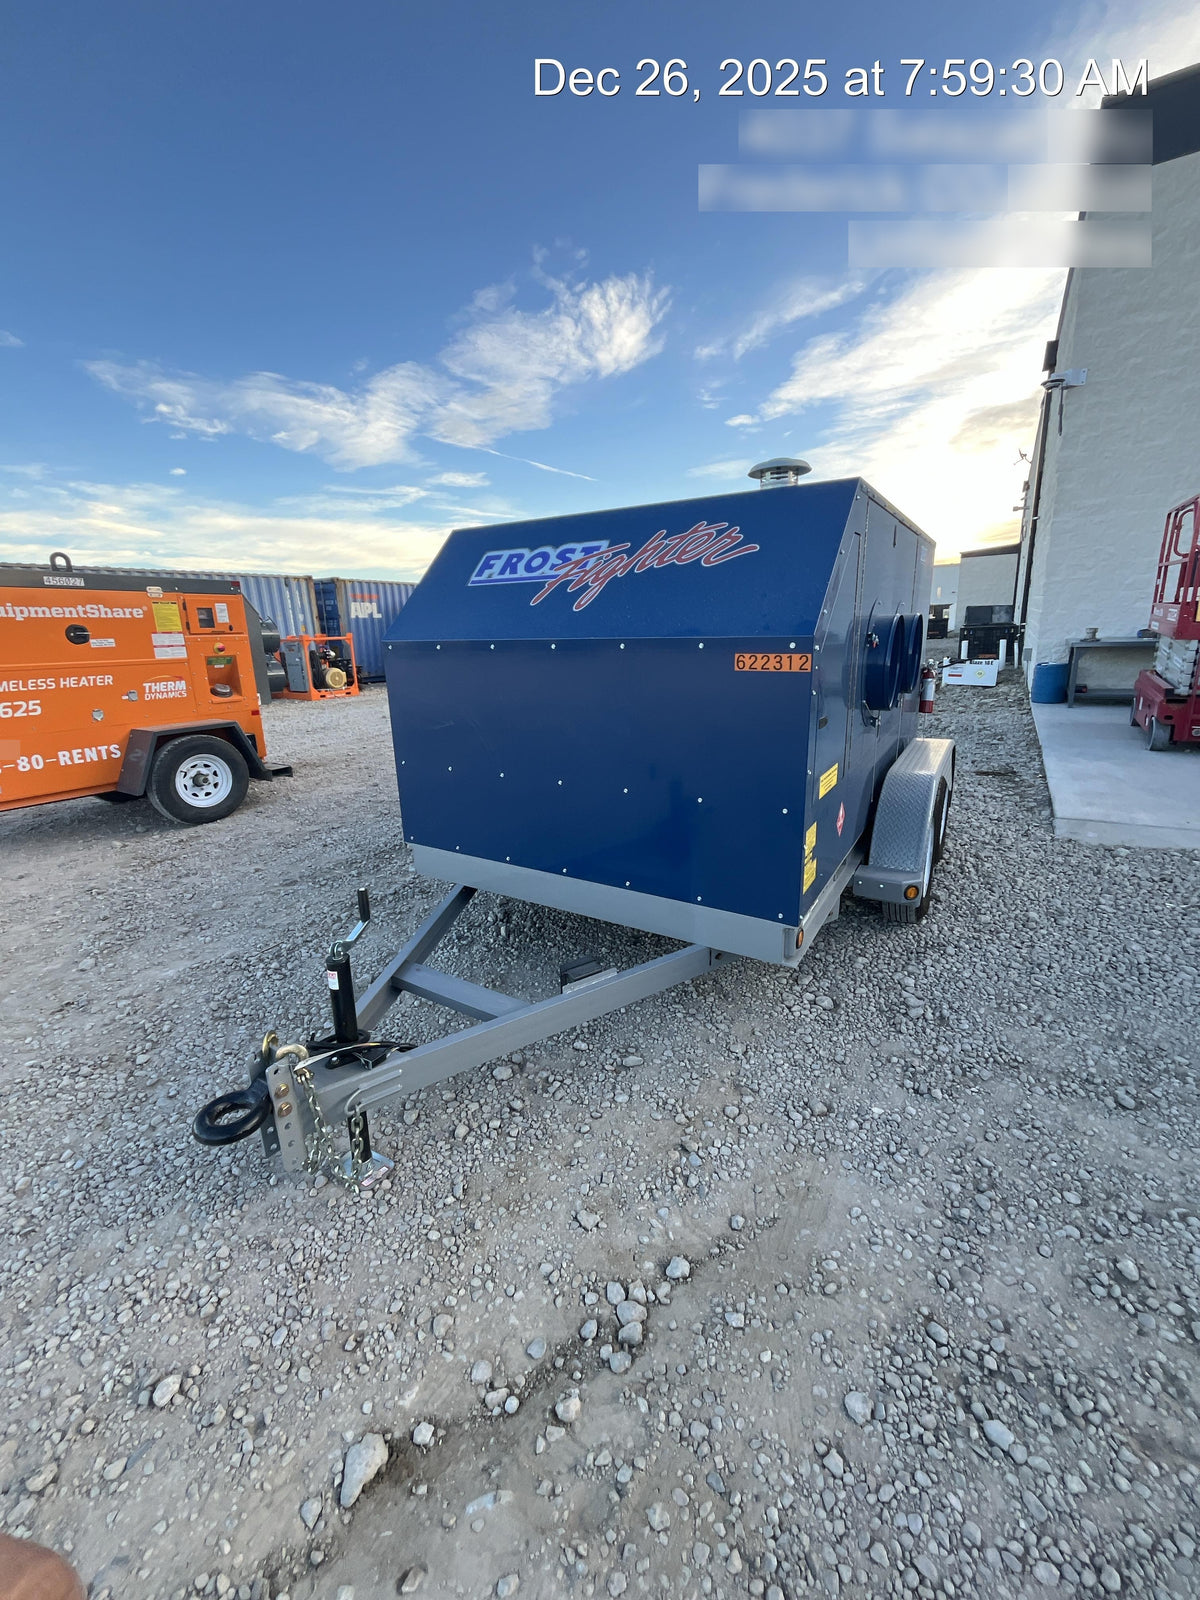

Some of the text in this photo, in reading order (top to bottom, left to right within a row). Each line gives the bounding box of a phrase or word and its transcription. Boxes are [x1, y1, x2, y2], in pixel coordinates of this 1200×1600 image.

[472, 543, 605, 580] FROST
[529, 520, 760, 612] Fighter
[351, 602, 382, 618] APL
[736, 654, 809, 671] 622312
[60, 674, 113, 689] HEATER
[143, 680, 187, 693] THERM
[144, 690, 187, 701] DYNAMICS
[0, 700, 42, 718] 625
